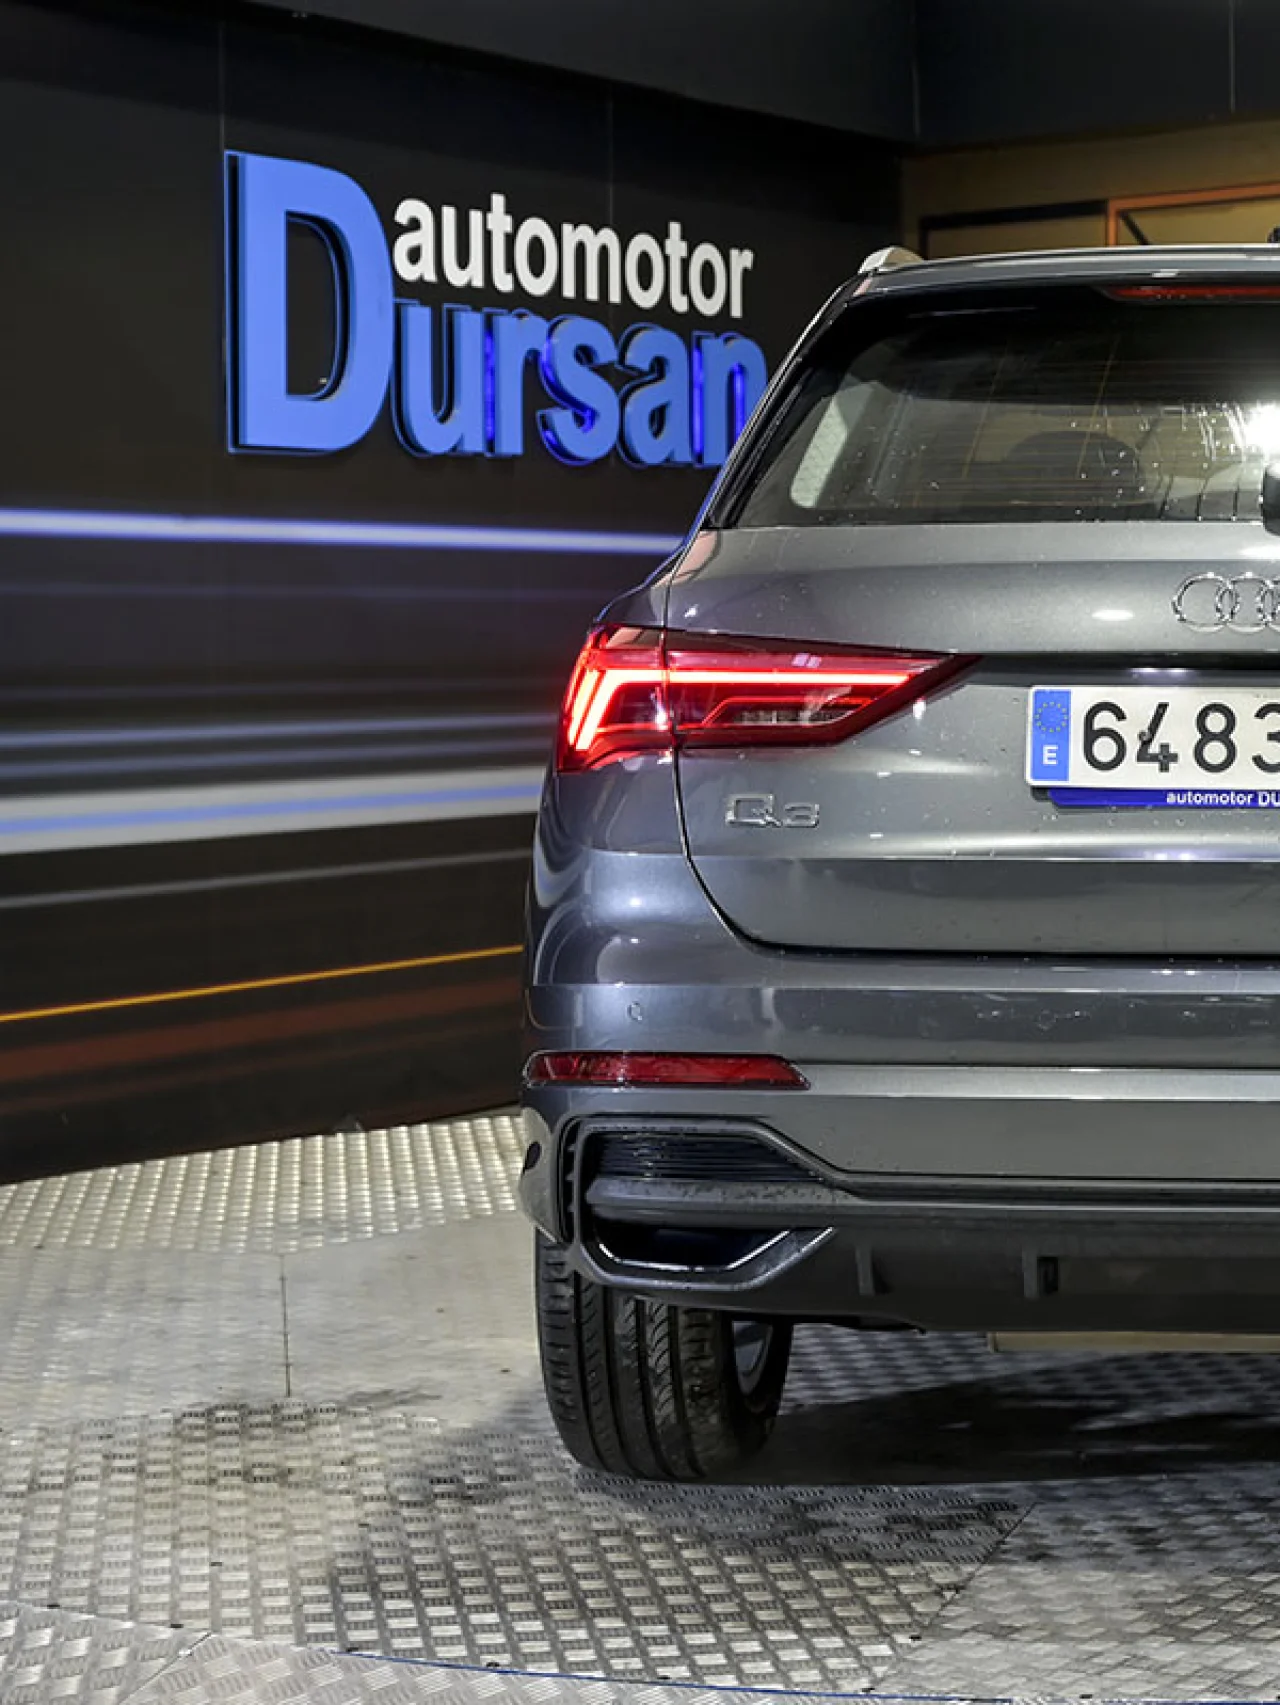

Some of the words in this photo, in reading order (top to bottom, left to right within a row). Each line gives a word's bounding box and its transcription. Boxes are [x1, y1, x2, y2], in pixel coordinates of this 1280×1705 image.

[393, 193, 755, 318] automotor
[224, 150, 769, 468] Dursan
[1042, 745, 1058, 765] E
[725, 793, 820, 828] Q3
[1166, 791, 1254, 806] automotor
